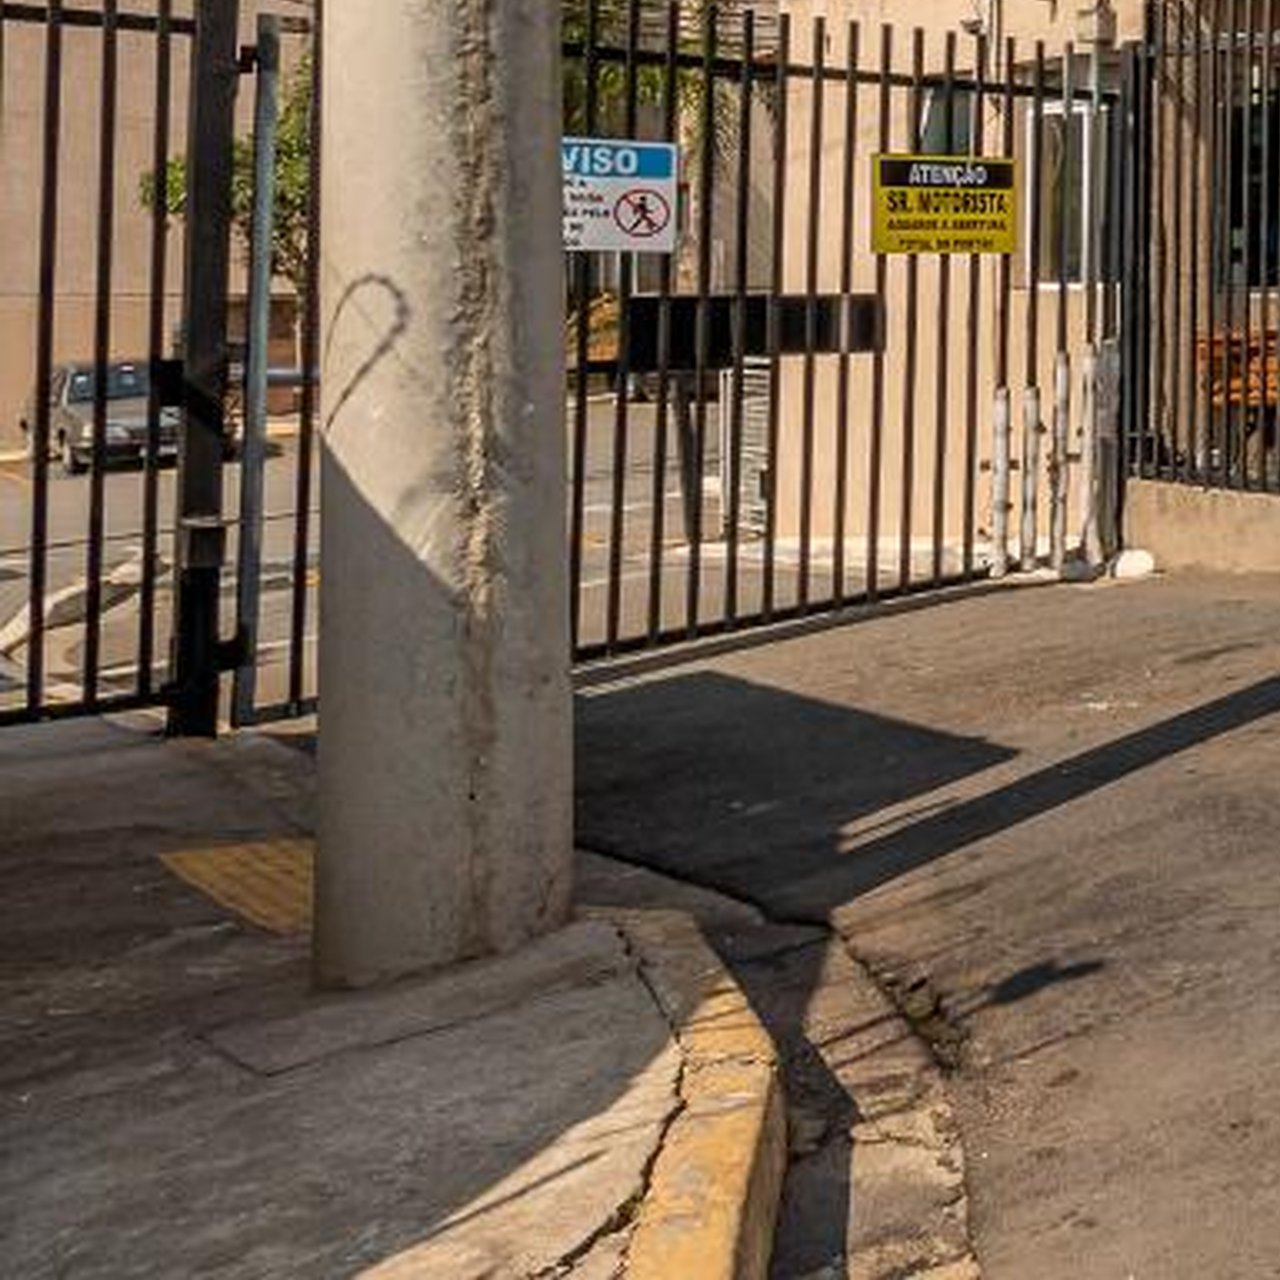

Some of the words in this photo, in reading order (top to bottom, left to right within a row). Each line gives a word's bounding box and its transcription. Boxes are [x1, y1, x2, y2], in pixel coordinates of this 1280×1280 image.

[562, 146, 639, 174] VISO
[908, 163, 988, 187] ATENÇÃO
[917, 191, 1008, 214] MOTORISTA
